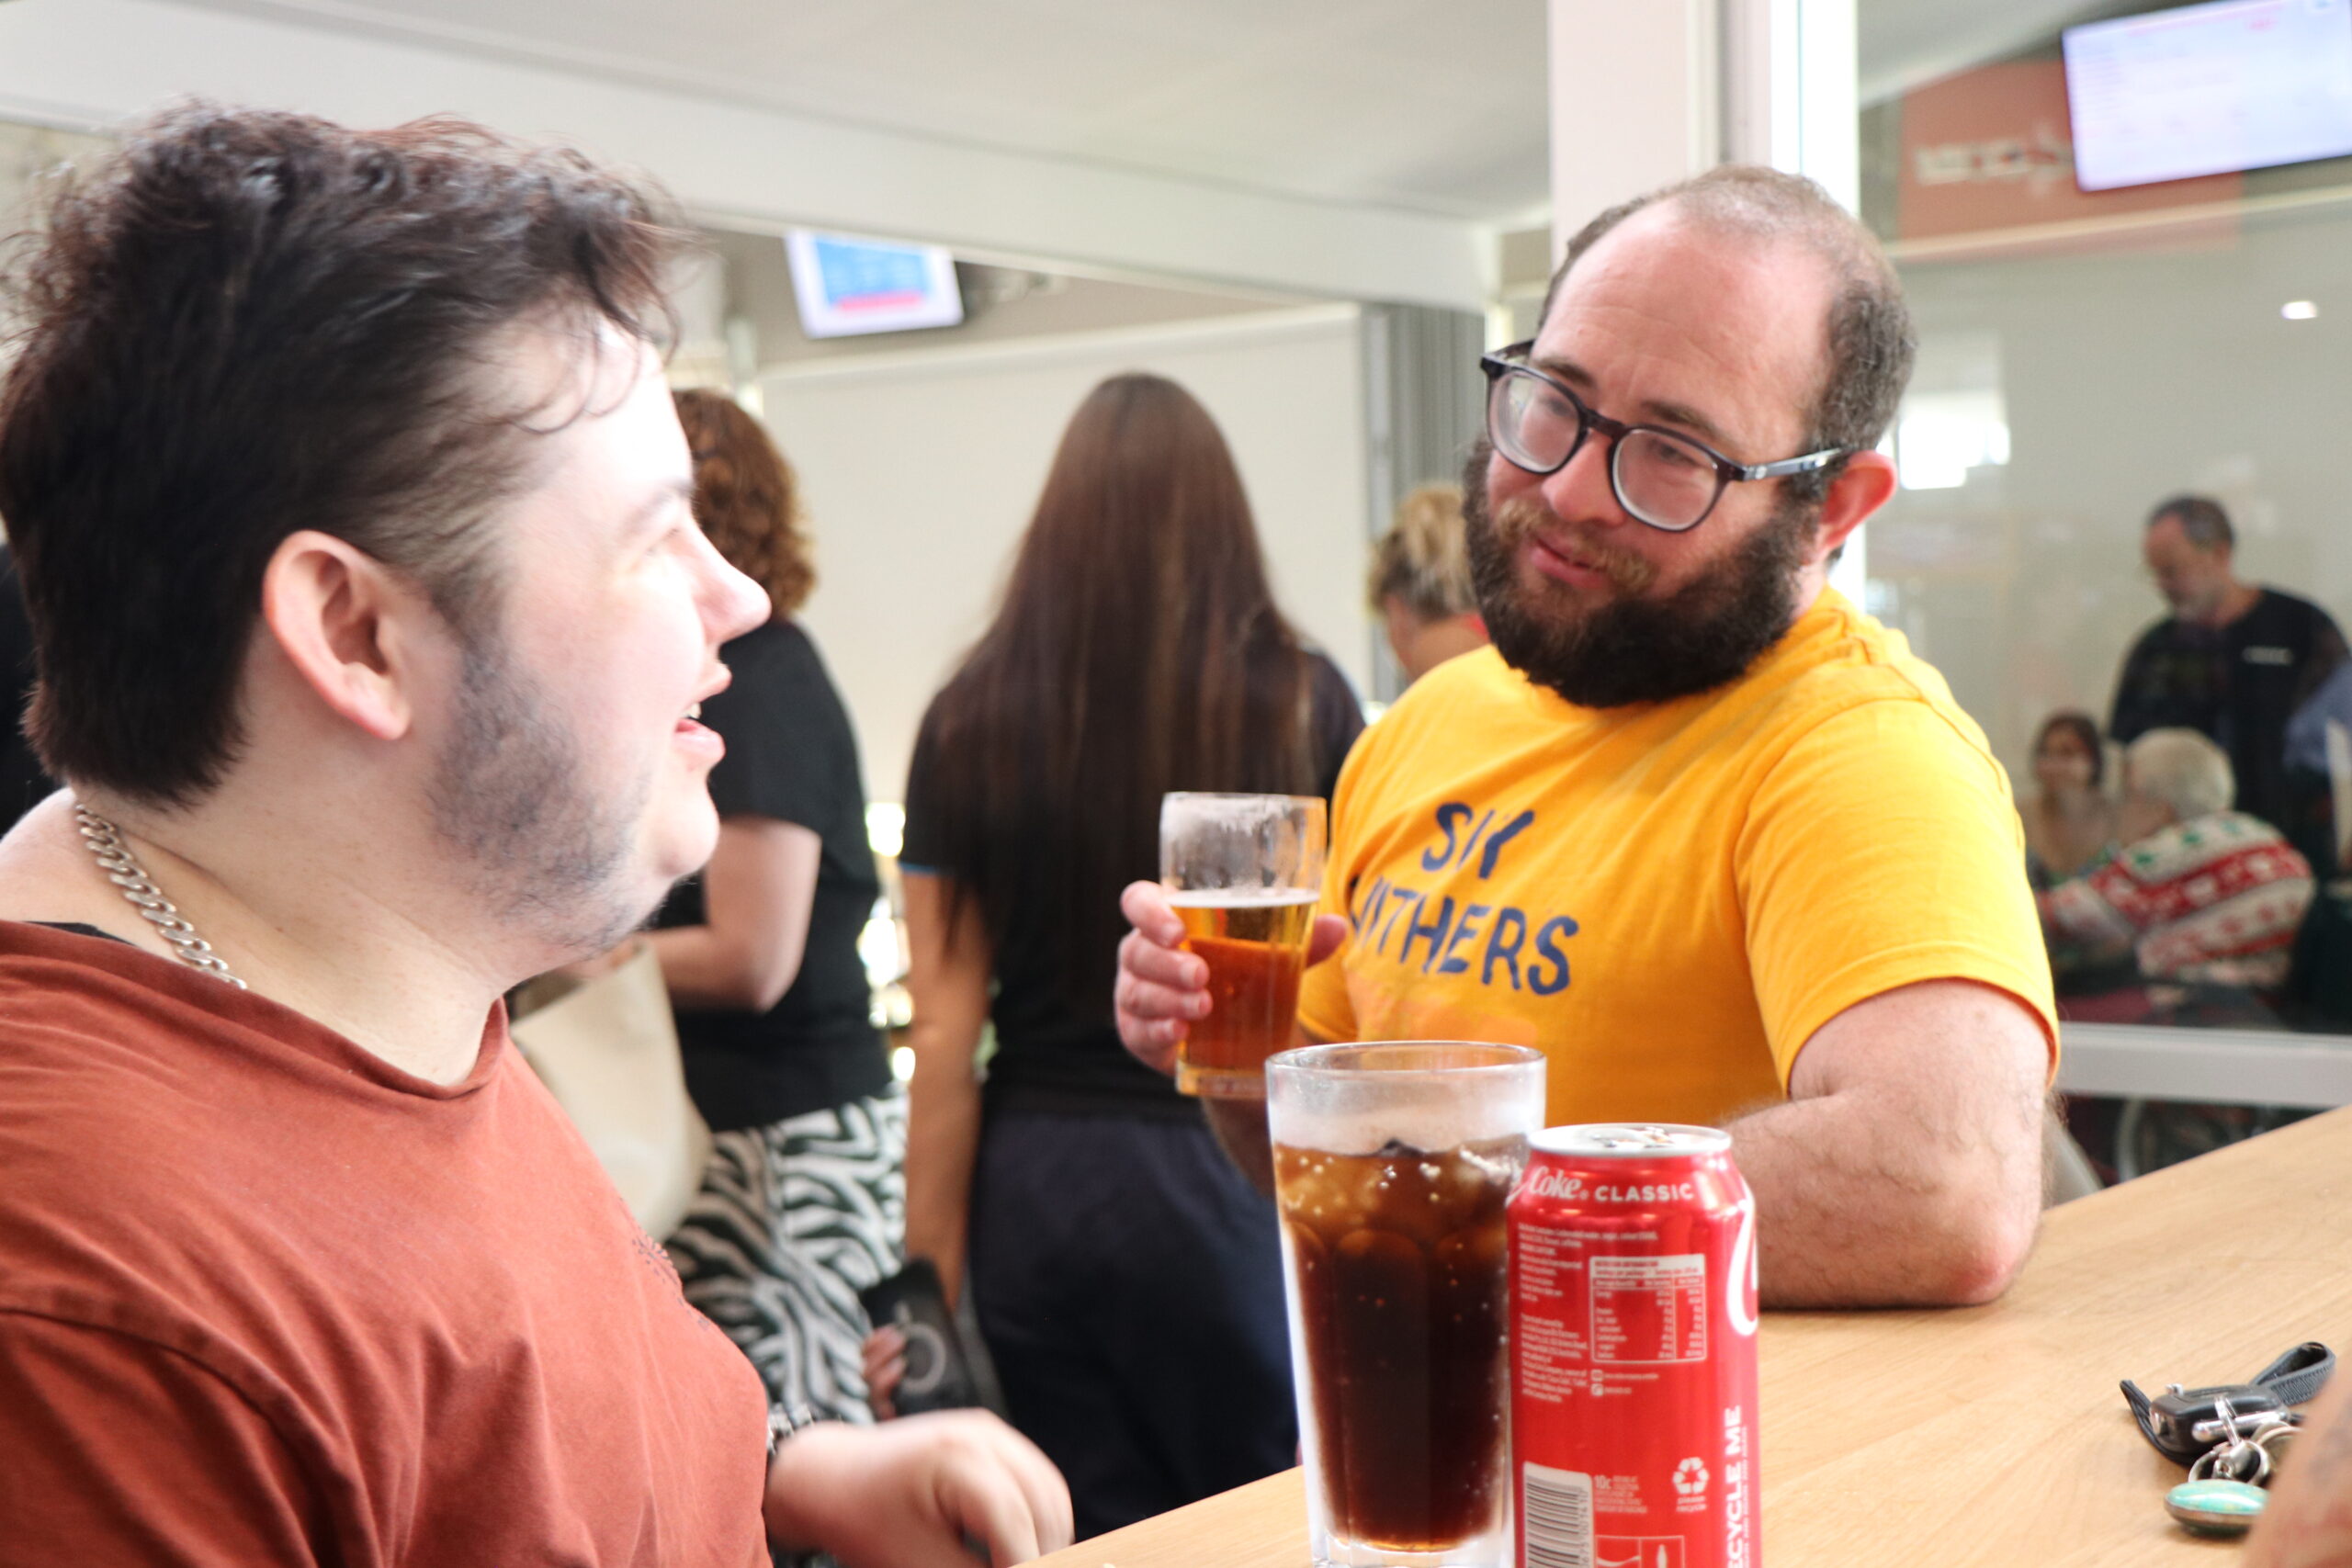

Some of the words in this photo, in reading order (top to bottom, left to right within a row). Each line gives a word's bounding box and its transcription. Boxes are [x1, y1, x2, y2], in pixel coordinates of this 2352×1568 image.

[1509, 1165, 1582, 1204] Coke
[1594, 1183, 1694, 1202] CLASSIC
[1724, 1405, 1742, 1456] ME
